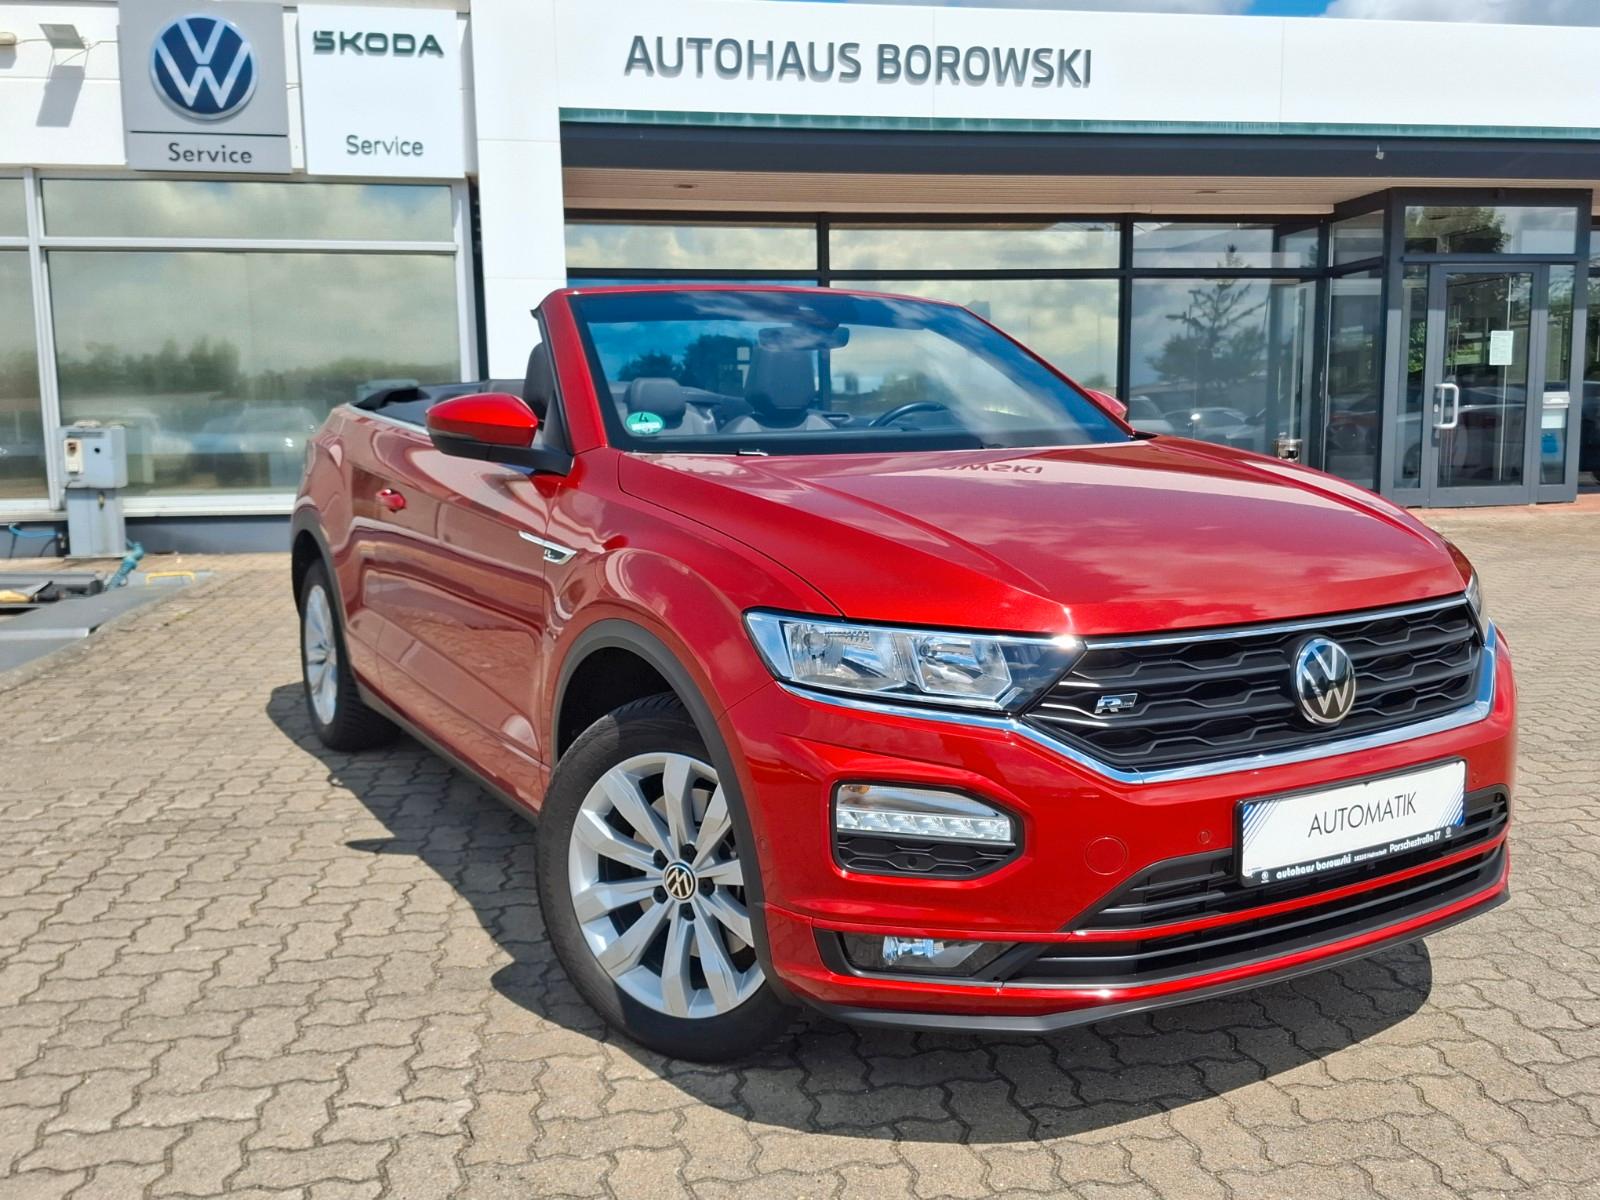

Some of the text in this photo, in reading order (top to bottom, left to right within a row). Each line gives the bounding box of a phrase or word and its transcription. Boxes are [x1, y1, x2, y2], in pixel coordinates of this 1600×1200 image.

[624, 35, 1092, 88] AUTOHAUS BOROWSKI
[167, 142, 253, 164] Service
[345, 134, 423, 157] Service
[1307, 791, 1417, 838] AUTOMATIK
[1276, 864, 1315, 879] autohaus
[1316, 853, 1352, 871] borowski
